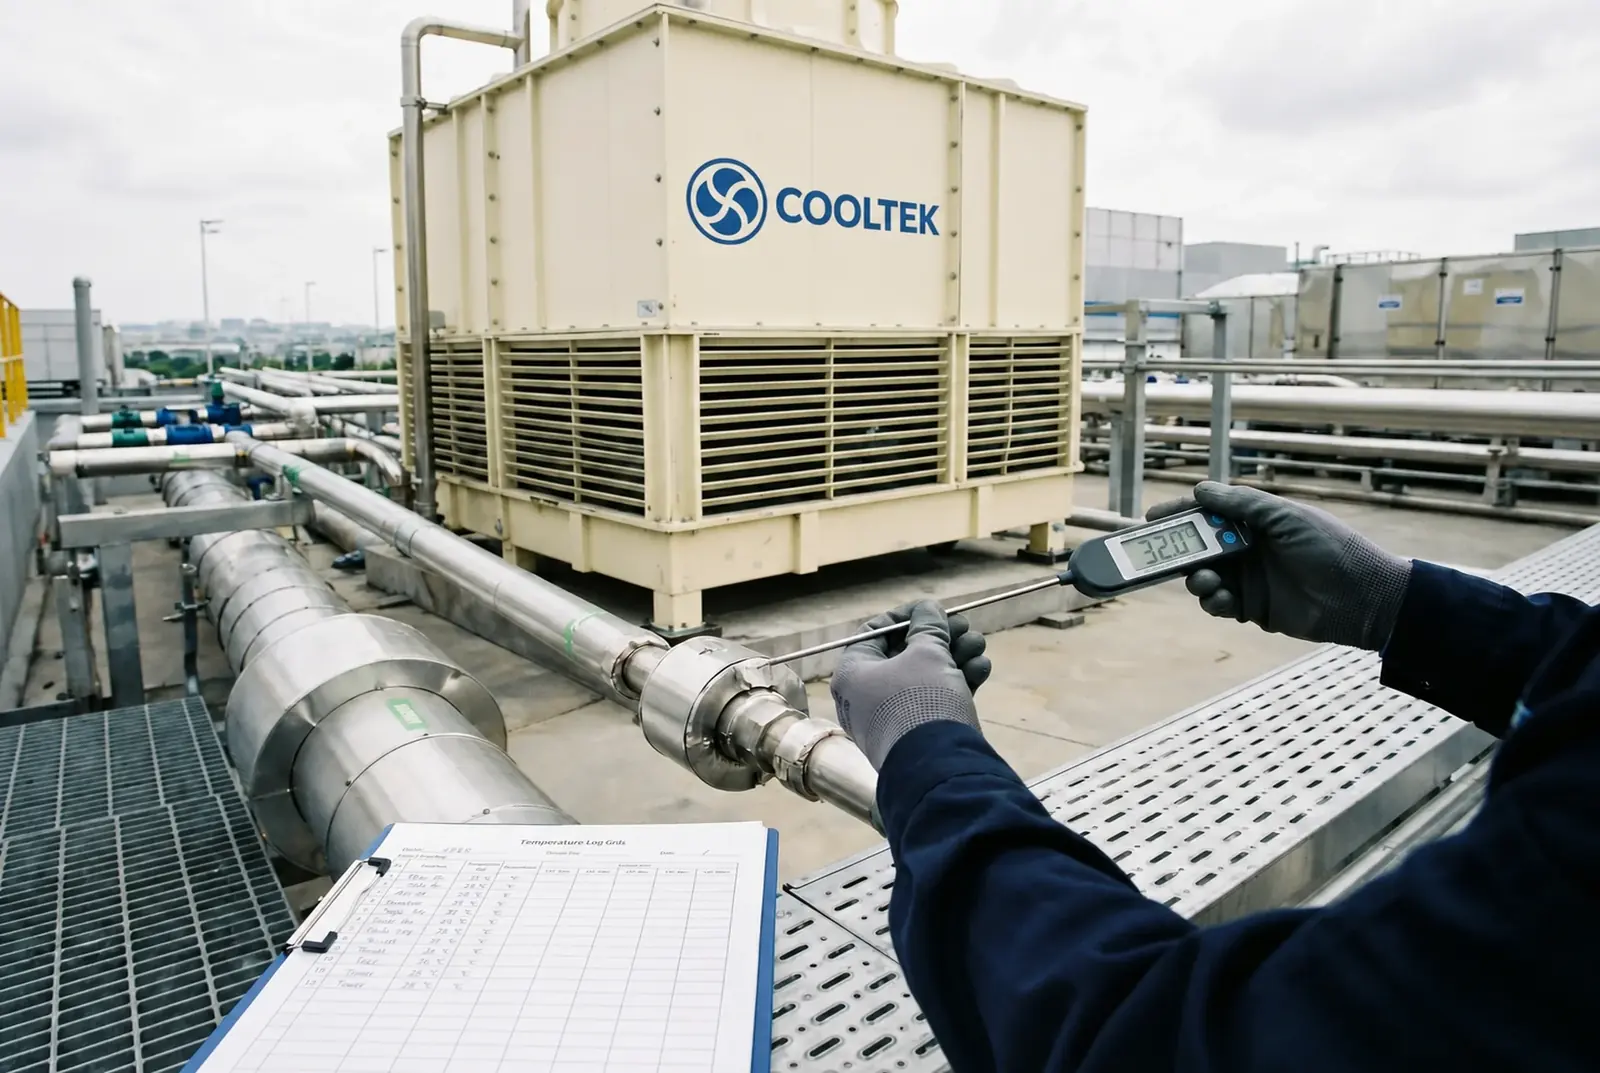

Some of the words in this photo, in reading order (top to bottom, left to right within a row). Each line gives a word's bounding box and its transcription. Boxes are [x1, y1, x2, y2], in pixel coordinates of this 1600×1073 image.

[776, 187, 939, 236] COOLTEK
[520, 839, 584, 847] Temperature
[586, 839, 604, 847] Log
